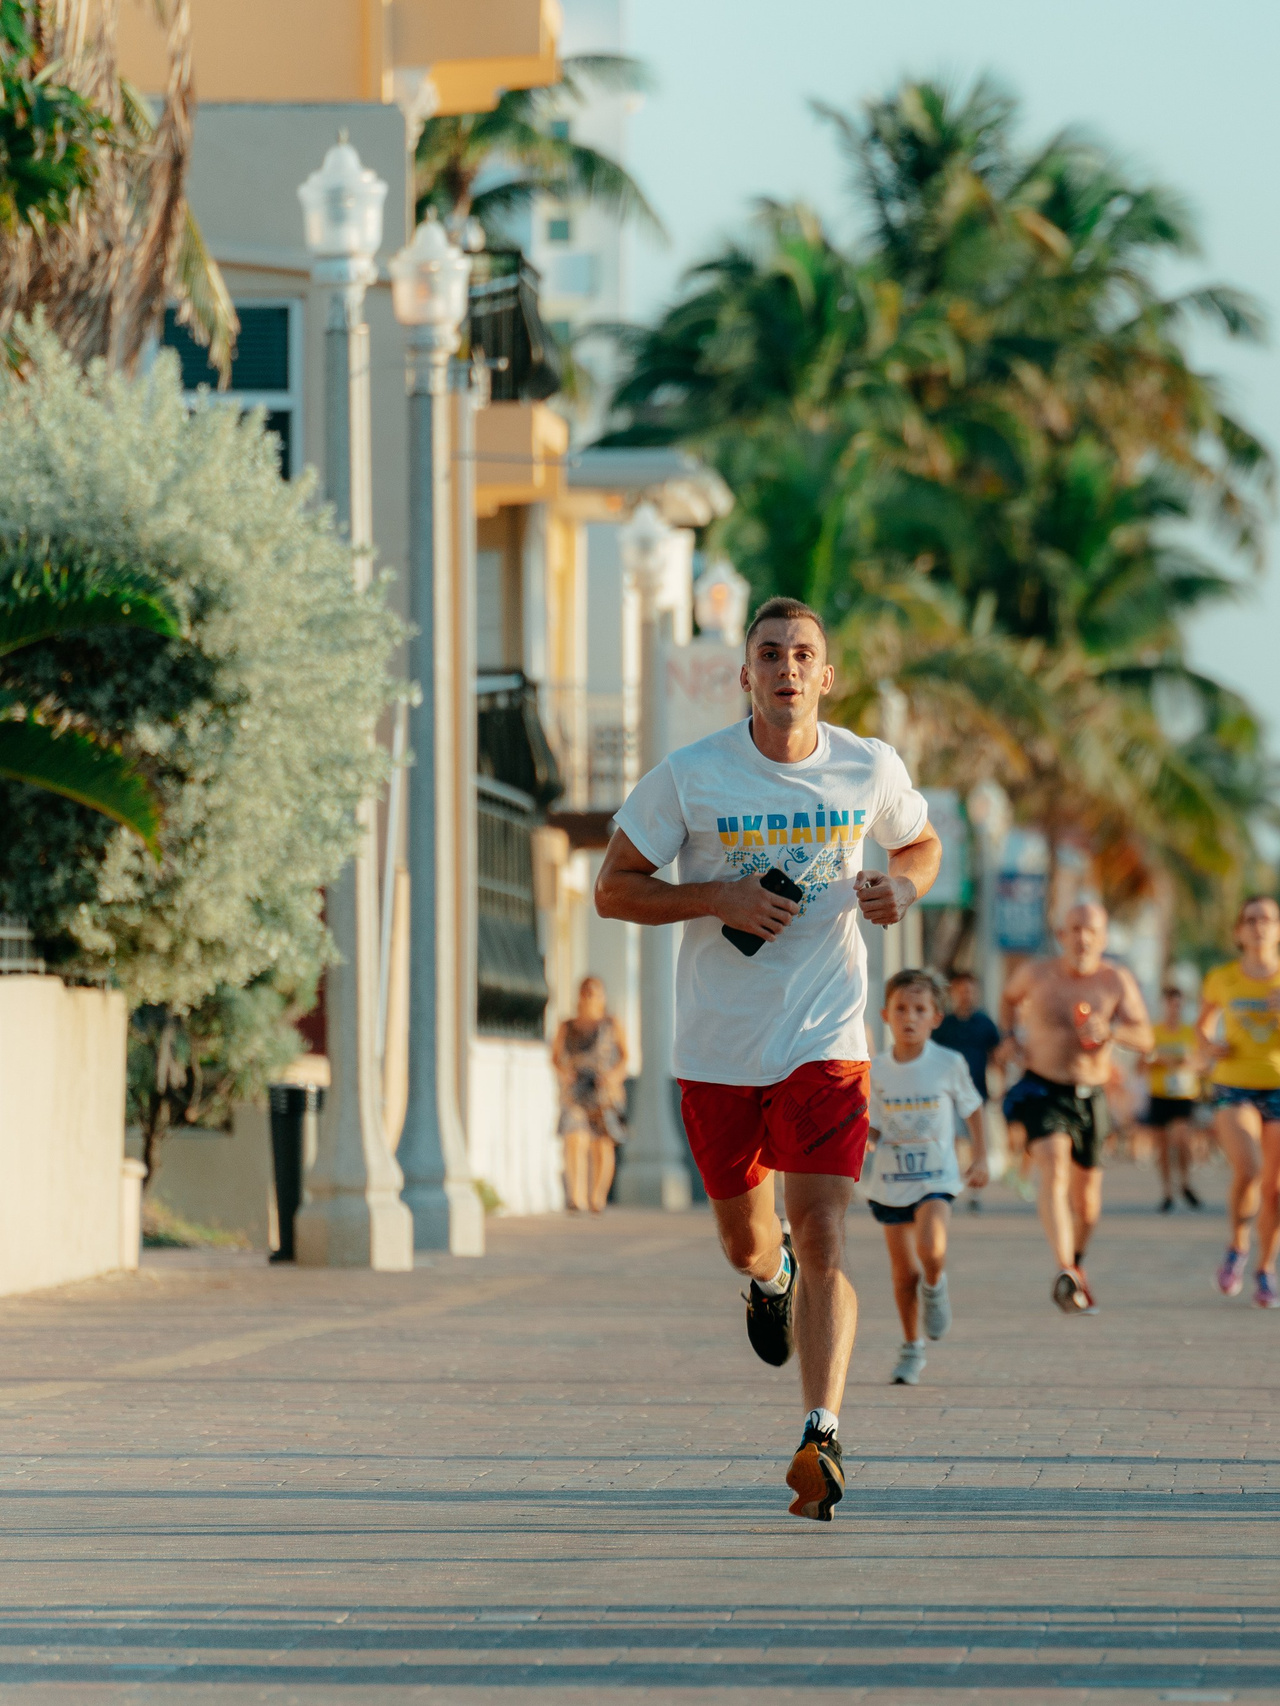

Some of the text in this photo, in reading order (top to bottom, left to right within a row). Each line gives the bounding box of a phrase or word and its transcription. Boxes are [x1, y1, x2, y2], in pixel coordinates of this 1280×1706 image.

[803, 1098, 868, 1155] UNDER ARMOU
[895, 1152, 927, 1173] 107
